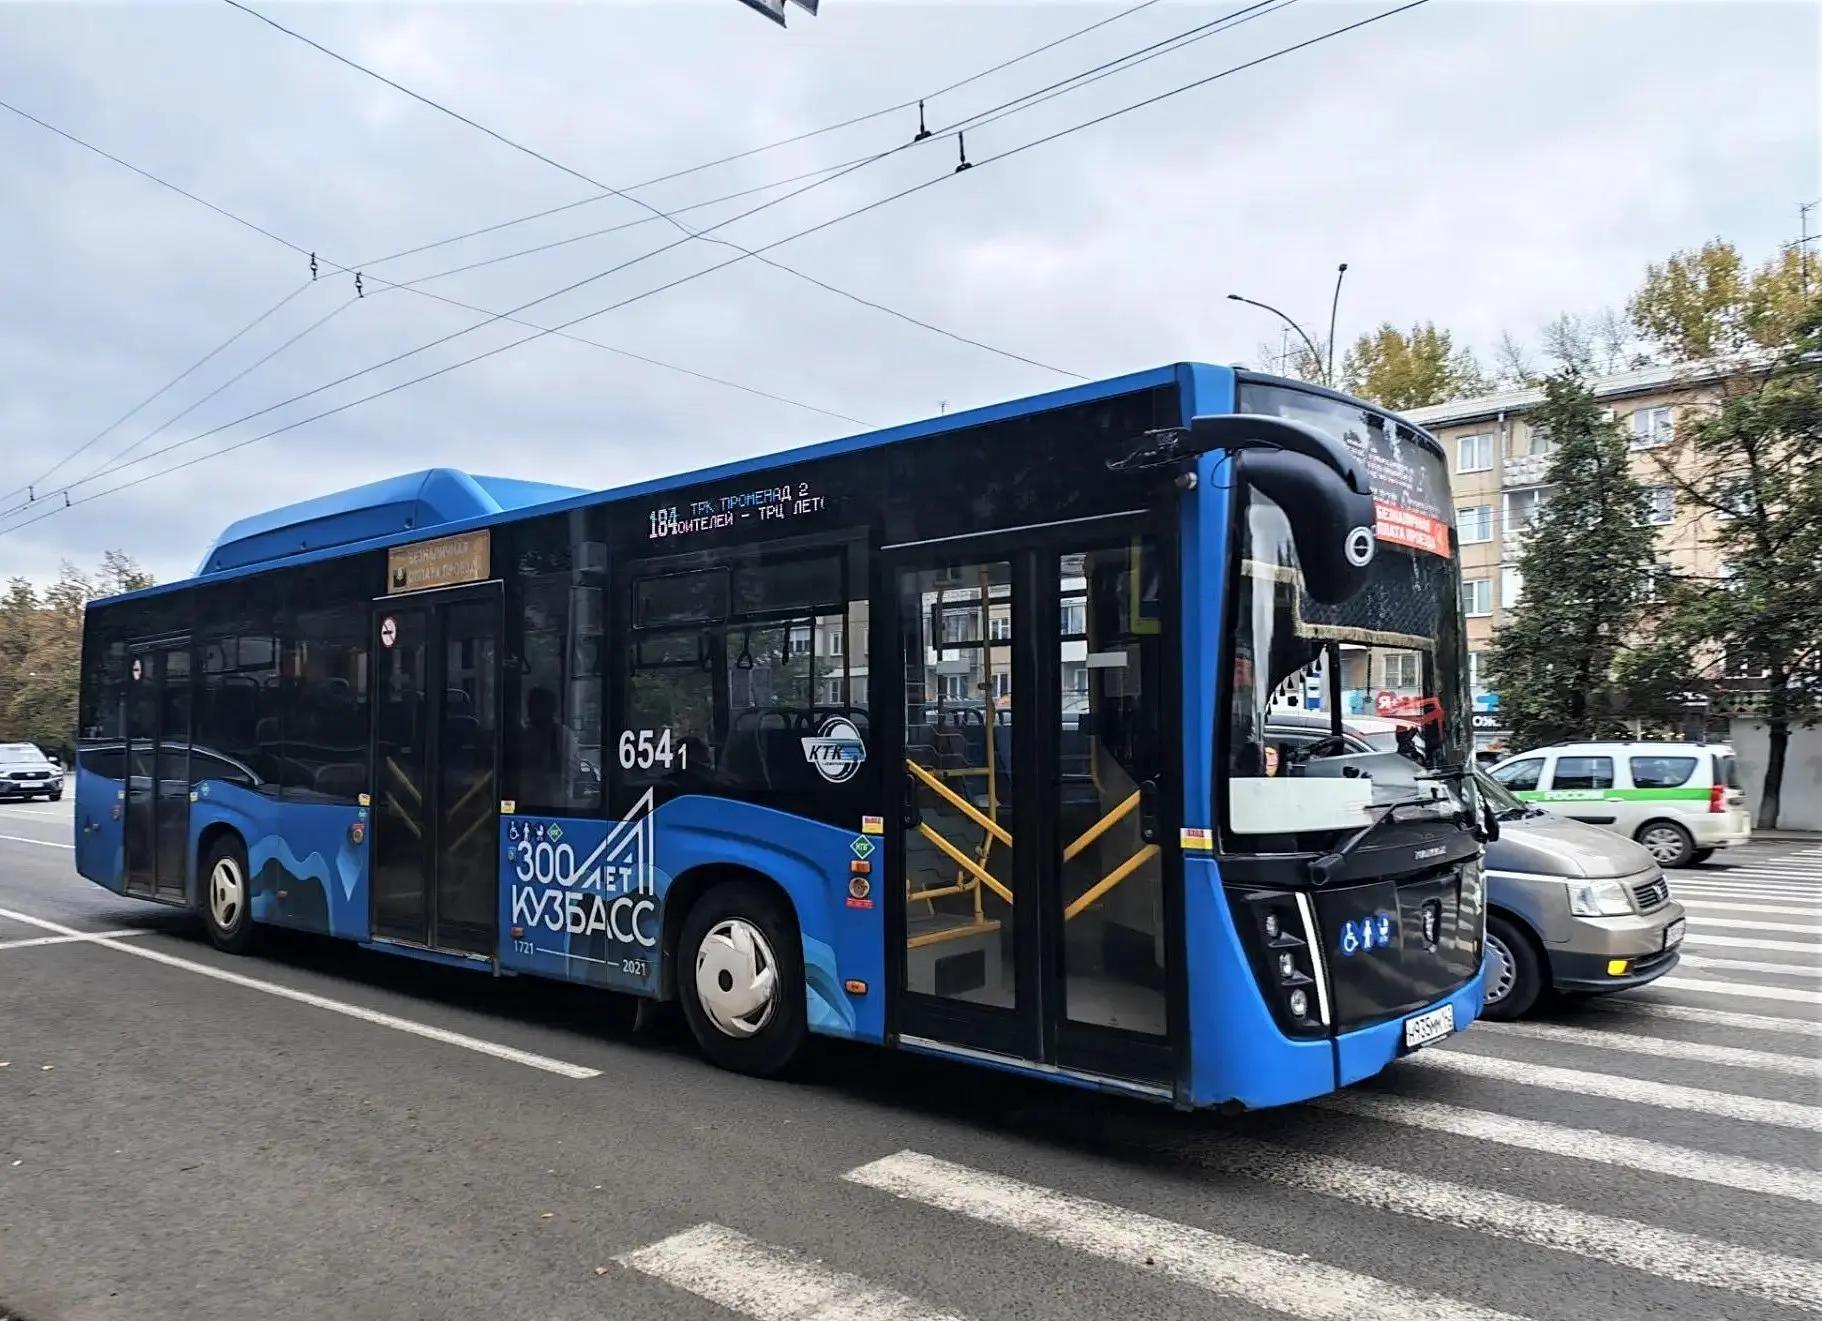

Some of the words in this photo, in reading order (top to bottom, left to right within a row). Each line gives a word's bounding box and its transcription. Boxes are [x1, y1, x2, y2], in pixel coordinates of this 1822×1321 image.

[690, 501, 715, 514] ТРК
[799, 482, 809, 497] 2
[758, 503, 785, 520] ТРЦ
[649, 507, 677, 538] 184
[809, 745, 843, 761] КТК
[516, 841, 575, 887] 300
[511, 884, 657, 947] КУЗБАСС
[514, 940, 535, 955] 1721
[622, 959, 649, 977] 2021
